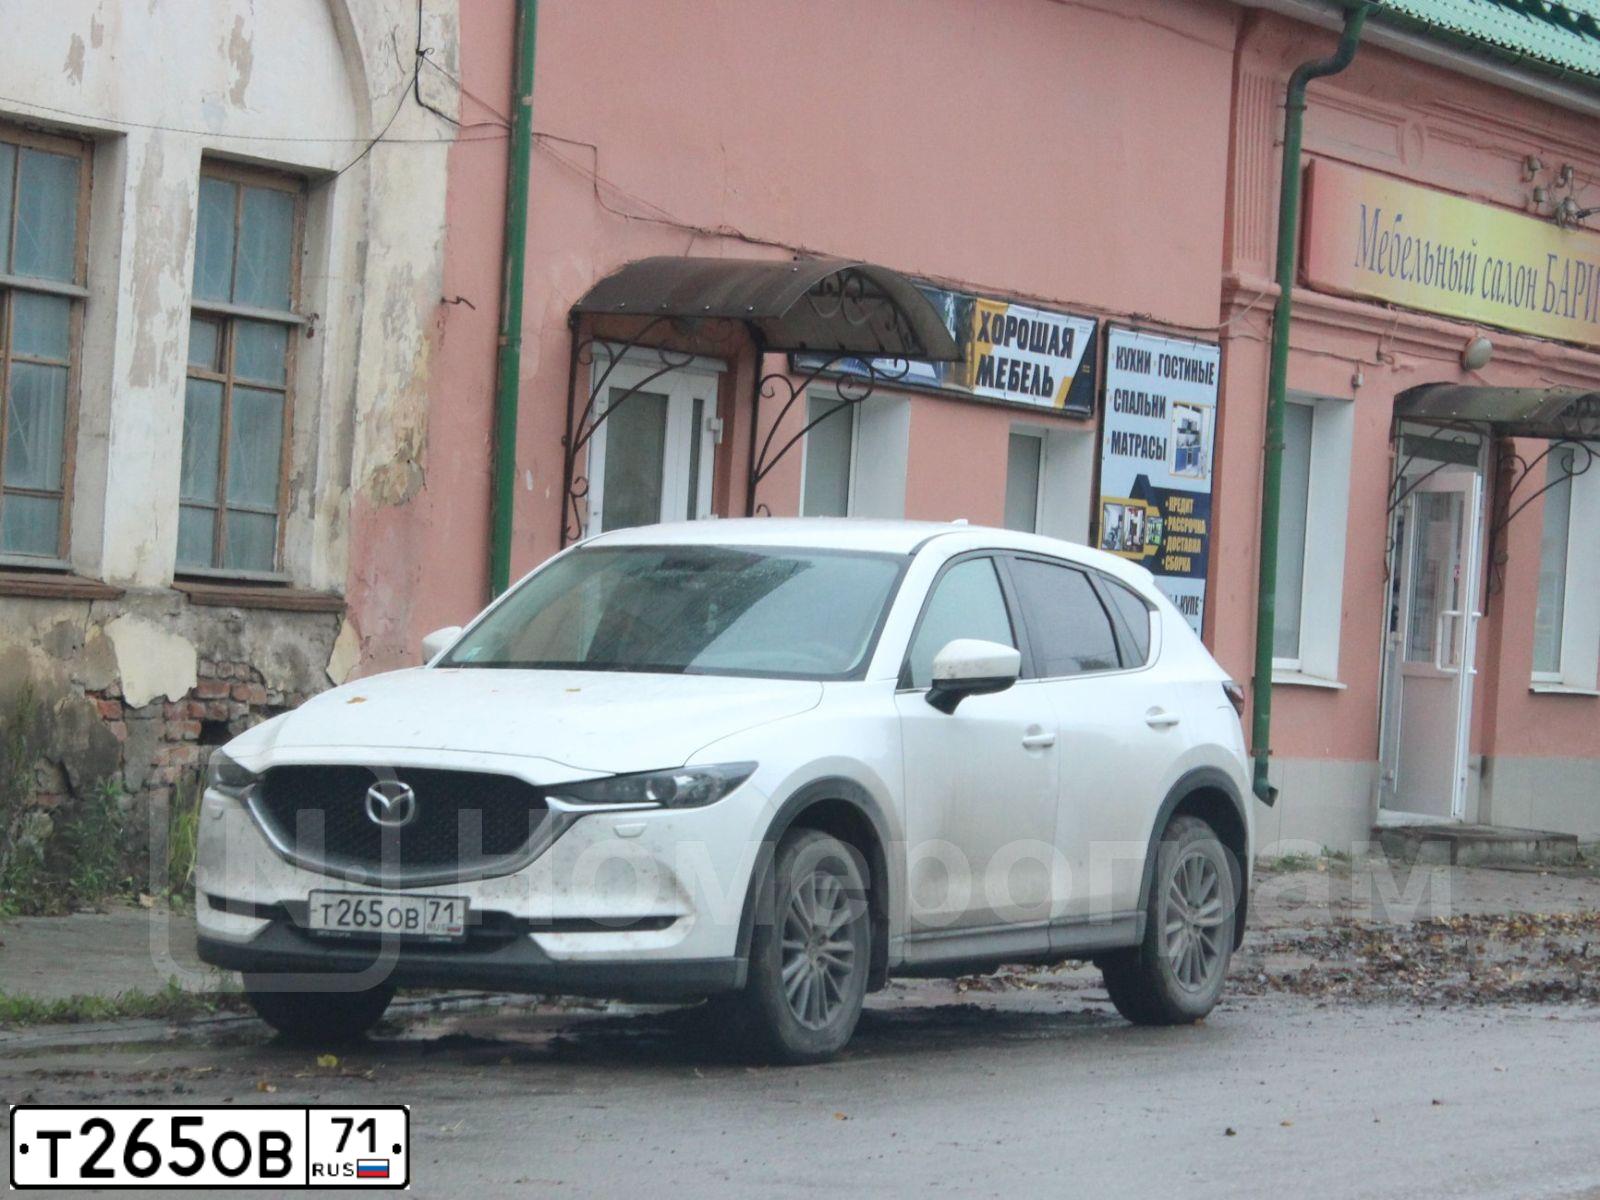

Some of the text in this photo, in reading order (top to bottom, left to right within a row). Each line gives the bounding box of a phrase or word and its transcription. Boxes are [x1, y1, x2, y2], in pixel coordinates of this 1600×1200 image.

[1354, 203, 1478, 295] Мебельный
[1482, 256, 1539, 311] салон
[976, 309, 1075, 359] ХОРОШАЯ
[975, 353, 1055, 398] МЕБЕЛЬ
[1115, 345, 1215, 385] КУХНИ ГОСТИНЫЕ
[1113, 388, 1167, 419] СПАЛЬНИ
[1110, 430, 1168, 461] МАТРАСЫ
[429, 901, 454, 923] 71
